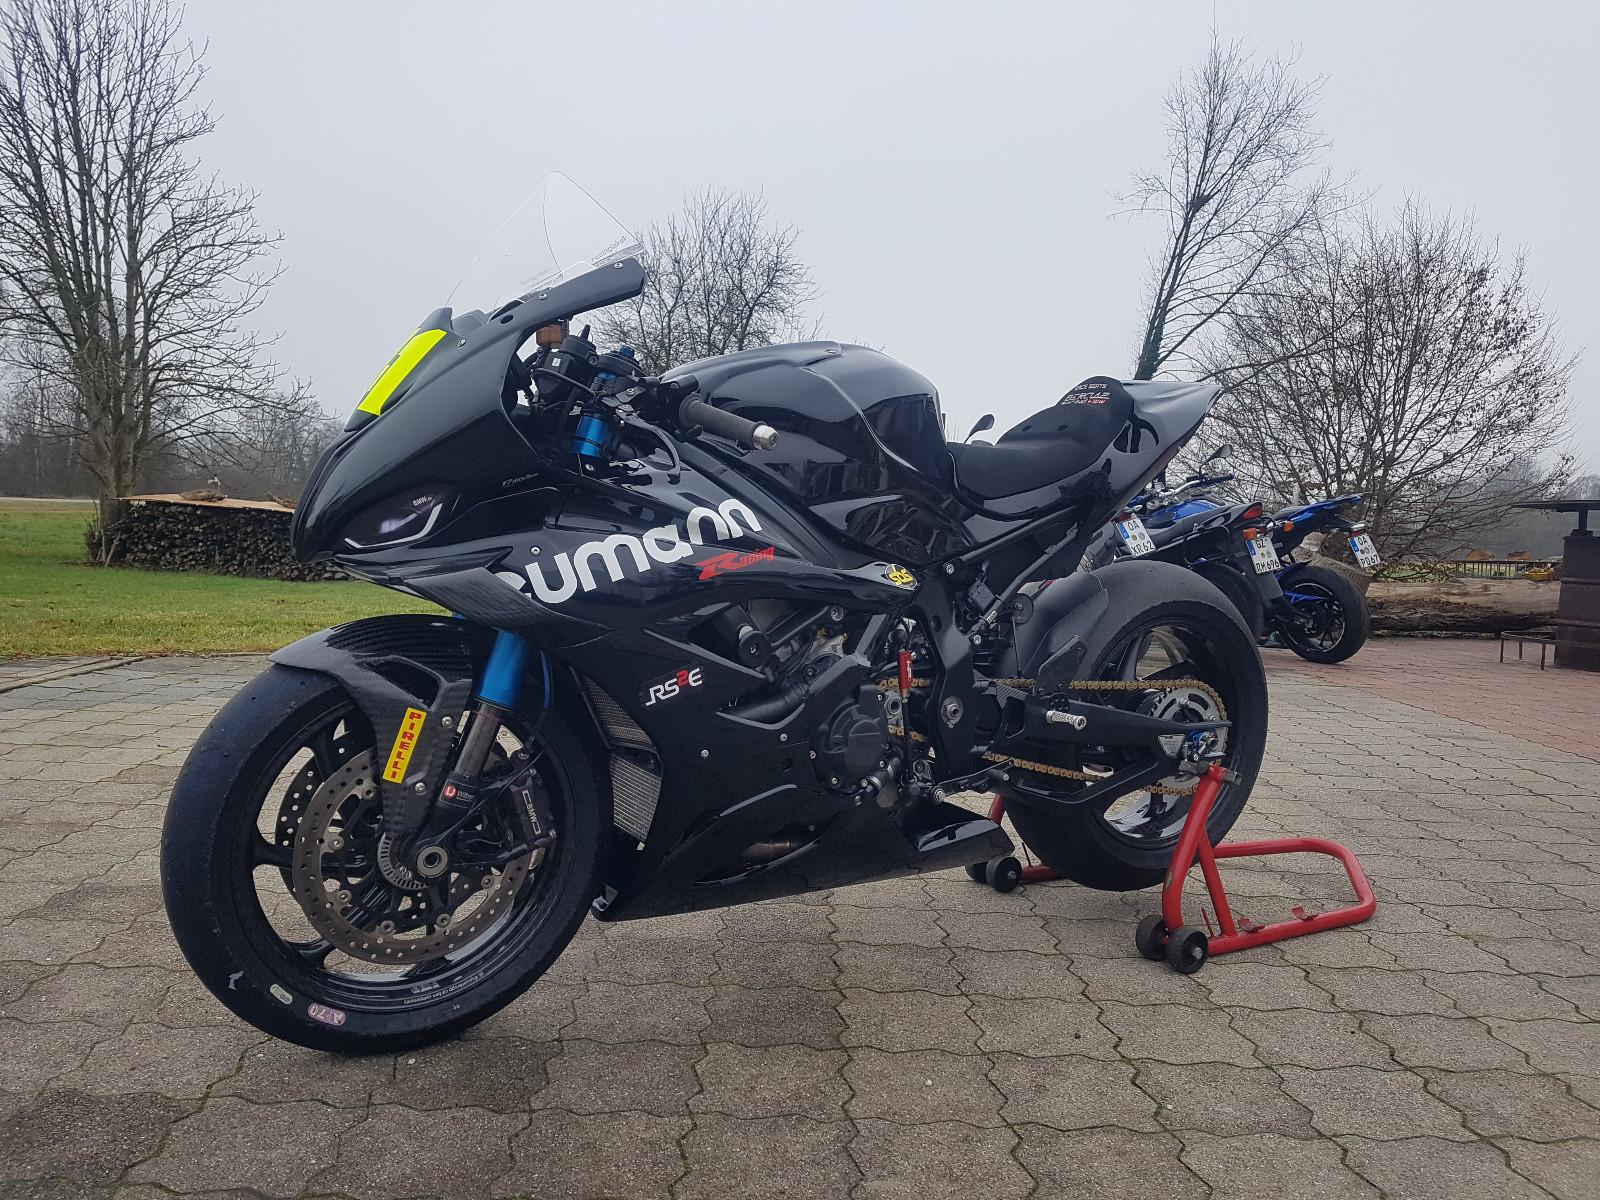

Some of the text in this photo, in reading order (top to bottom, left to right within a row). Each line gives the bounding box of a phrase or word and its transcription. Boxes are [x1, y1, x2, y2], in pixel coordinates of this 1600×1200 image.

[412, 496, 427, 506] BMW
[1127, 520, 1140, 531] OA
[390, 711, 422, 780] PIRELLI
[526, 802, 539, 823] BMW
